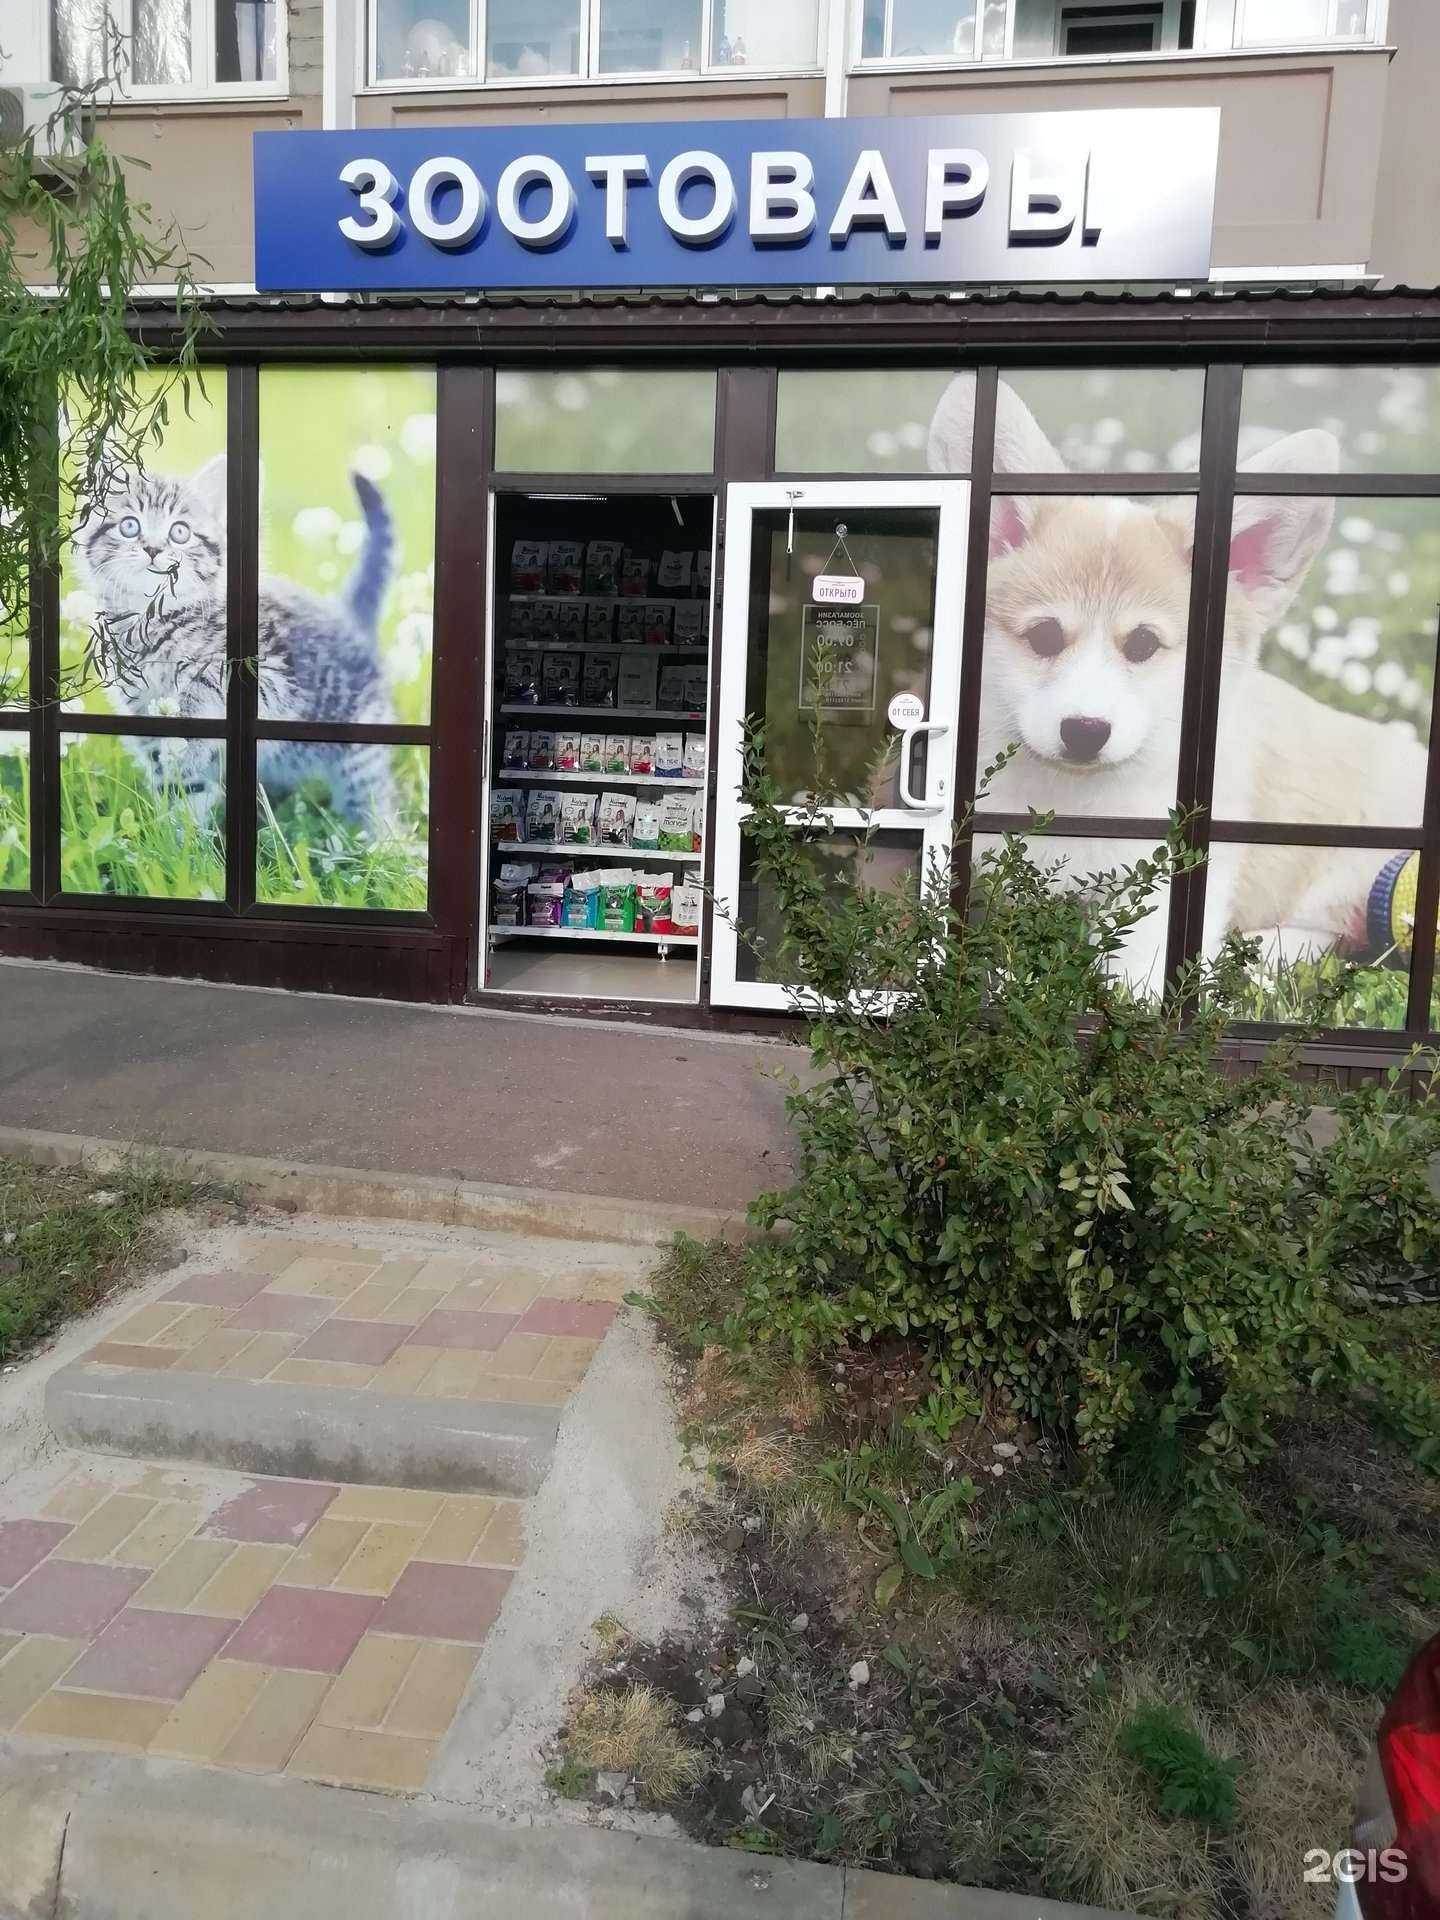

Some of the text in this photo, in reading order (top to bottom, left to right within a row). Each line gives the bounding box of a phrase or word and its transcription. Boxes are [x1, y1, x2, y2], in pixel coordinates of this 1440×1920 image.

[338, 147, 1102, 250] ЗООТОВАРЫ
[819, 587, 857, 599] ОТКРЫТО
[892, 708, 920, 717] ОТ СЕБЯ
